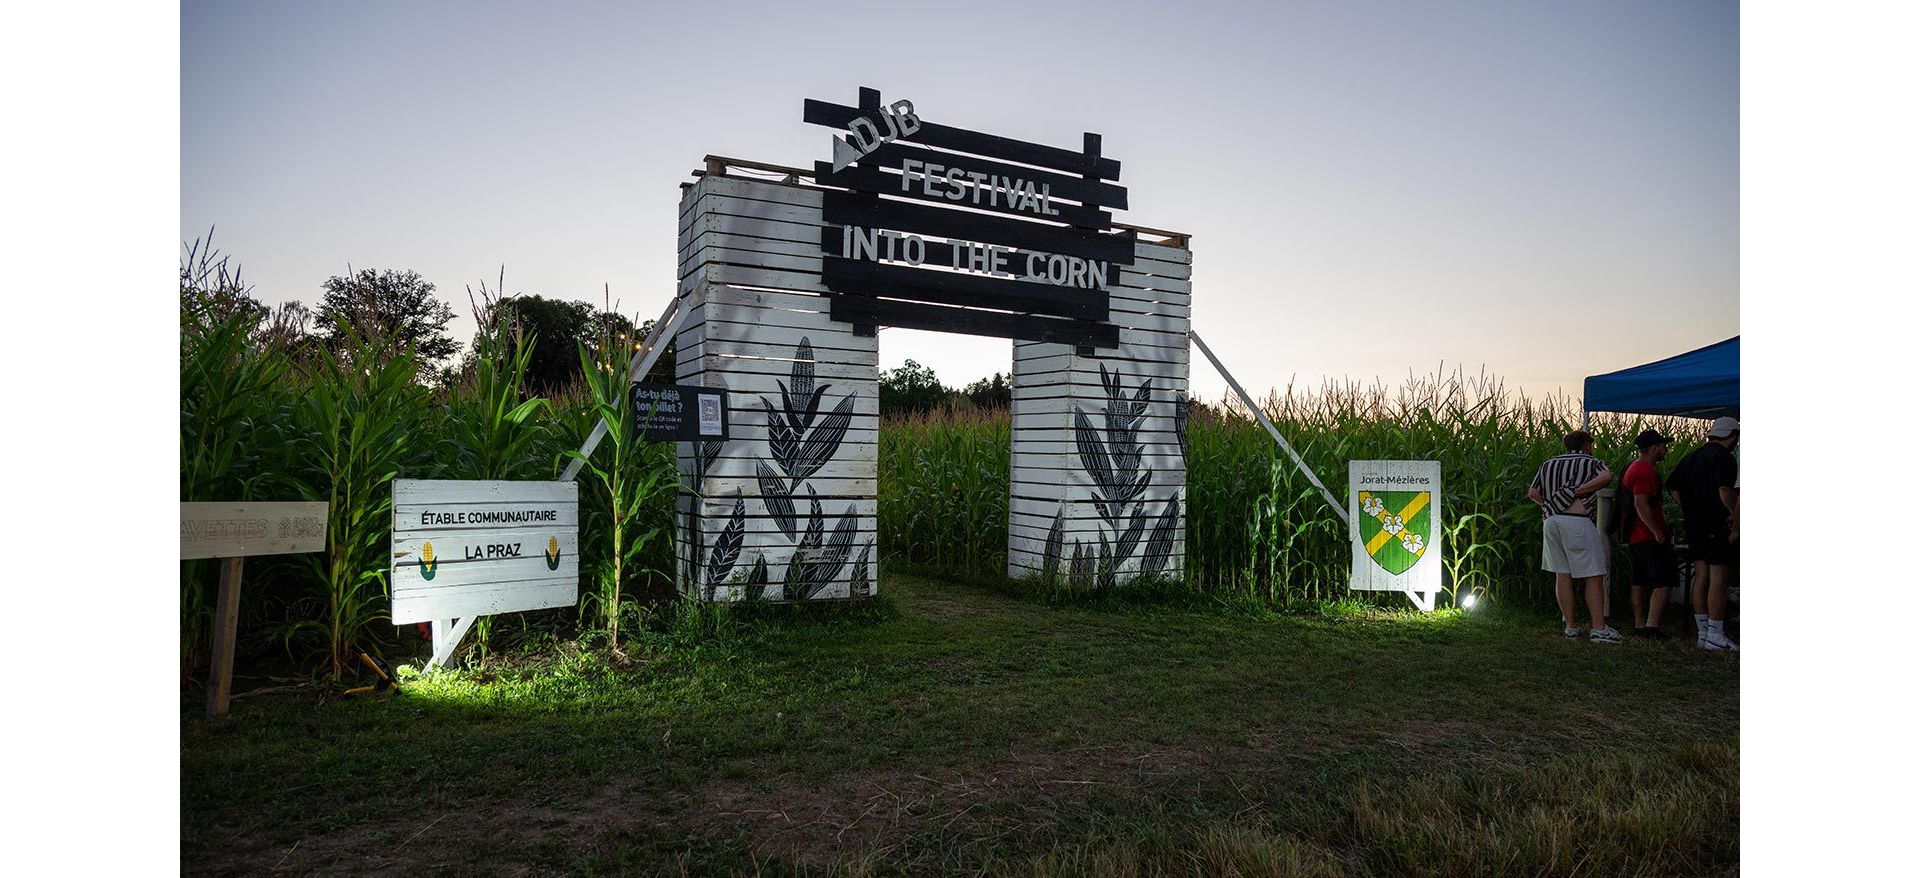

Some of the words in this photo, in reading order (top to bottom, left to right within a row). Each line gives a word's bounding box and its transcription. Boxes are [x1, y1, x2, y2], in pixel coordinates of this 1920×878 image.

[847, 99, 921, 155] DJB
[901, 157, 1059, 216] FESTIVAL
[843, 225, 926, 266] INTO
[946, 239, 1009, 277] THE
[1026, 251, 1108, 290] CORN
[661, 389, 680, 402] déjà
[636, 401, 651, 411] ton
[1360, 475, 1430, 485] Jorat-Mézières
[421, 511, 466, 525] ÉTABLE
[468, 510, 557, 524] COMMUNAUTAIRE
[464, 545, 484, 560] LA
[487, 542, 522, 558] PRAZ
